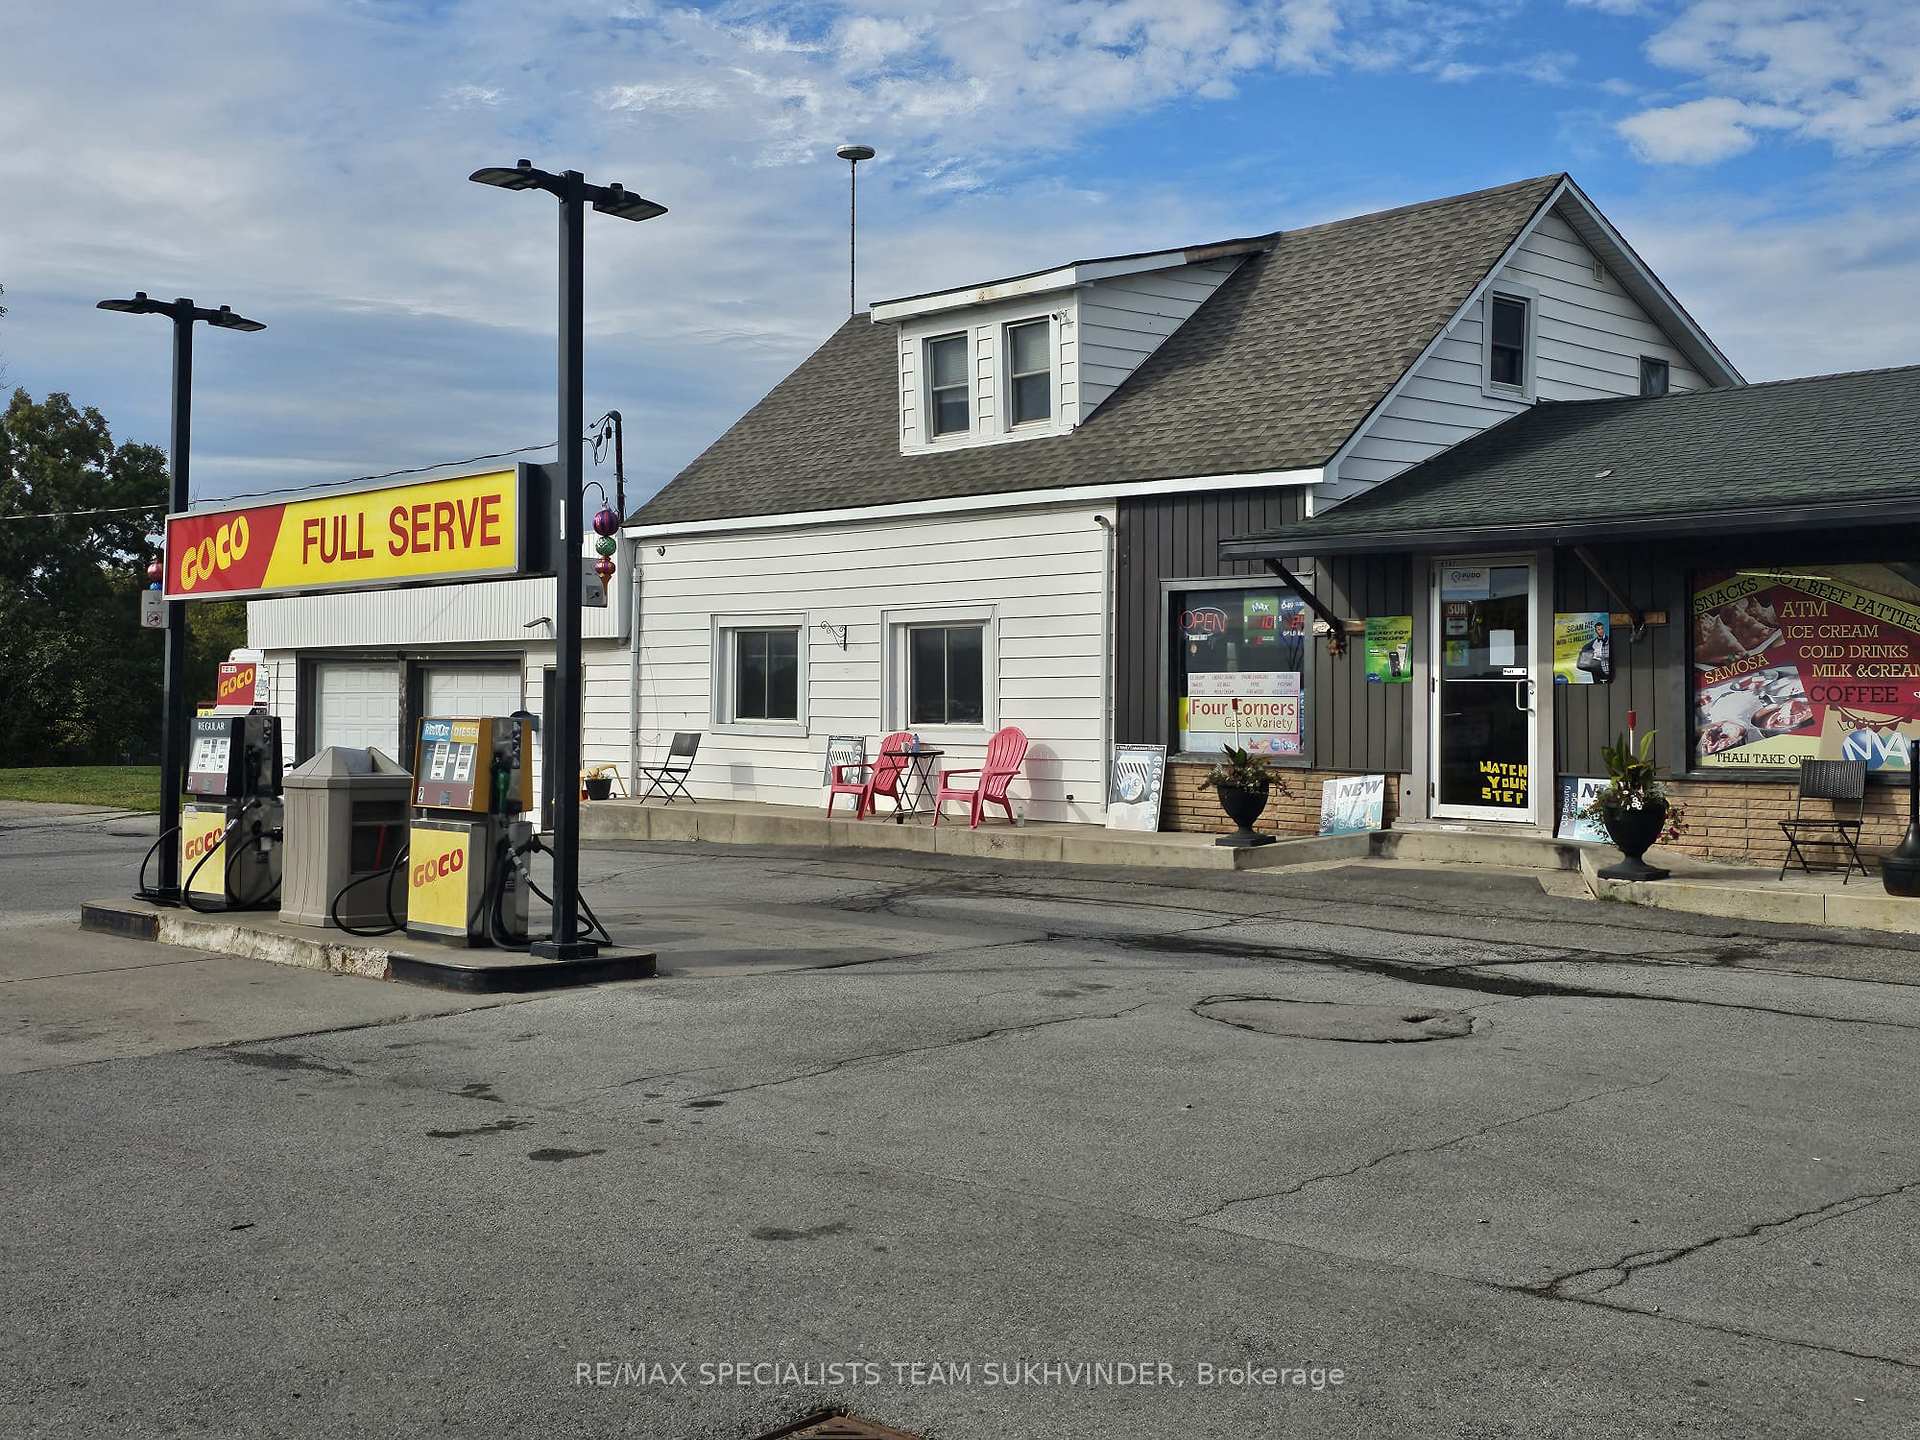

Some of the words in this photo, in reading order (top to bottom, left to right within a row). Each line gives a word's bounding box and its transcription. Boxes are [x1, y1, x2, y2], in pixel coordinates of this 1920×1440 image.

[302, 512, 374, 565] FULL
[388, 494, 501, 557] SERVE
[181, 515, 249, 590] GOCO
[1695, 577, 1758, 613] SNACKS
[1806, 579, 1851, 603] BEEF
[1780, 600, 1828, 618] ATM
[1180, 610, 1225, 632] OPEN
[1787, 626, 1814, 639] ICE
[1818, 625, 1879, 638] CREAM
[1799, 645, 1844, 659] COLD
[1849, 645, 1909, 658] DRINKS
[1704, 654, 1770, 684] SAMOSA
[1812, 664, 1851, 678] MILK
[220, 668, 253, 697] GOCO
[1810, 686, 1898, 703] COFFEE
[1192, 699, 1228, 715] Four
[198, 721, 225, 731] REGULAR
[1224, 716, 1242, 728] Gas
[1245, 716, 1253, 728] &
[1256, 716, 1293, 732] Variety
[1715, 753, 1750, 764] THALI
[1753, 754, 1786, 764] TAKE
[1480, 761, 1527, 777] WATCH
[1339, 779, 1383, 798] NEW
[1487, 776, 1527, 791] YOUR
[1482, 788, 1523, 804] STEP
[1562, 785, 1571, 813] Beauty
[185, 827, 223, 861] GOCO
[413, 848, 464, 888] GOCO
